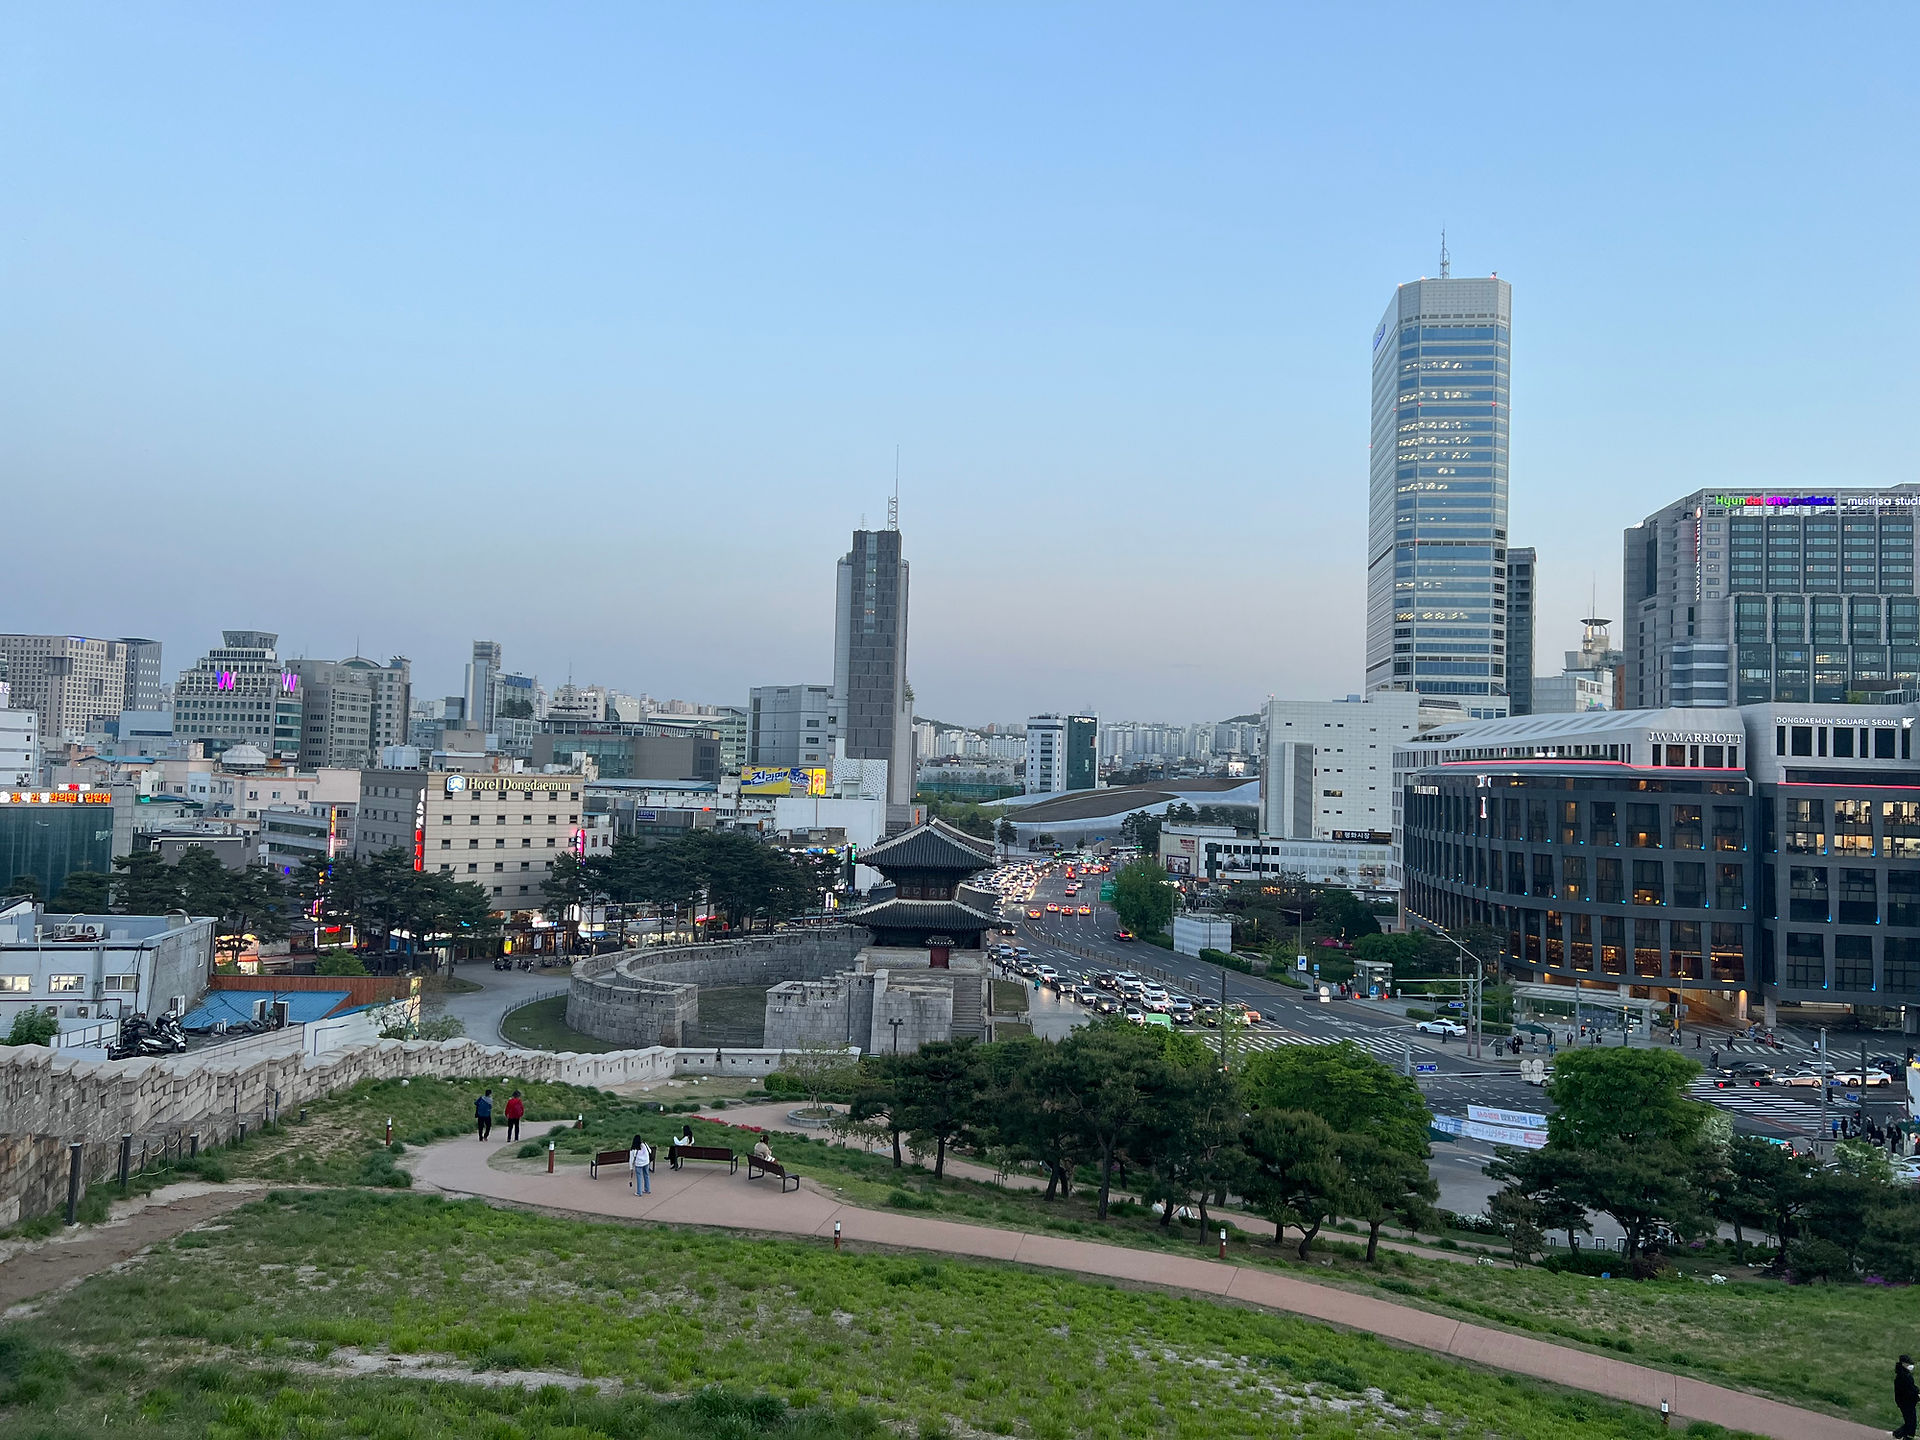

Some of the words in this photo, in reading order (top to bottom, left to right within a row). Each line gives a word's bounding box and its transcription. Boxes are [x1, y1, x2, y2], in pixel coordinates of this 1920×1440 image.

[1715, 495, 1764, 508] Hyundai
[1766, 495, 1790, 509] city
[1847, 496, 1892, 506] musinsa
[1776, 716, 1834, 725] DONGDAEMUN
[1836, 718, 1869, 726] SQUARE
[1871, 719, 1899, 727] SEOUL
[1648, 731, 1669, 742] JW
[1672, 732, 1744, 744] MARRIOTT
[750, 770, 784, 785] 진라면
[467, 777, 499, 791] Hotel
[502, 778, 571, 792] Dongdaemun
